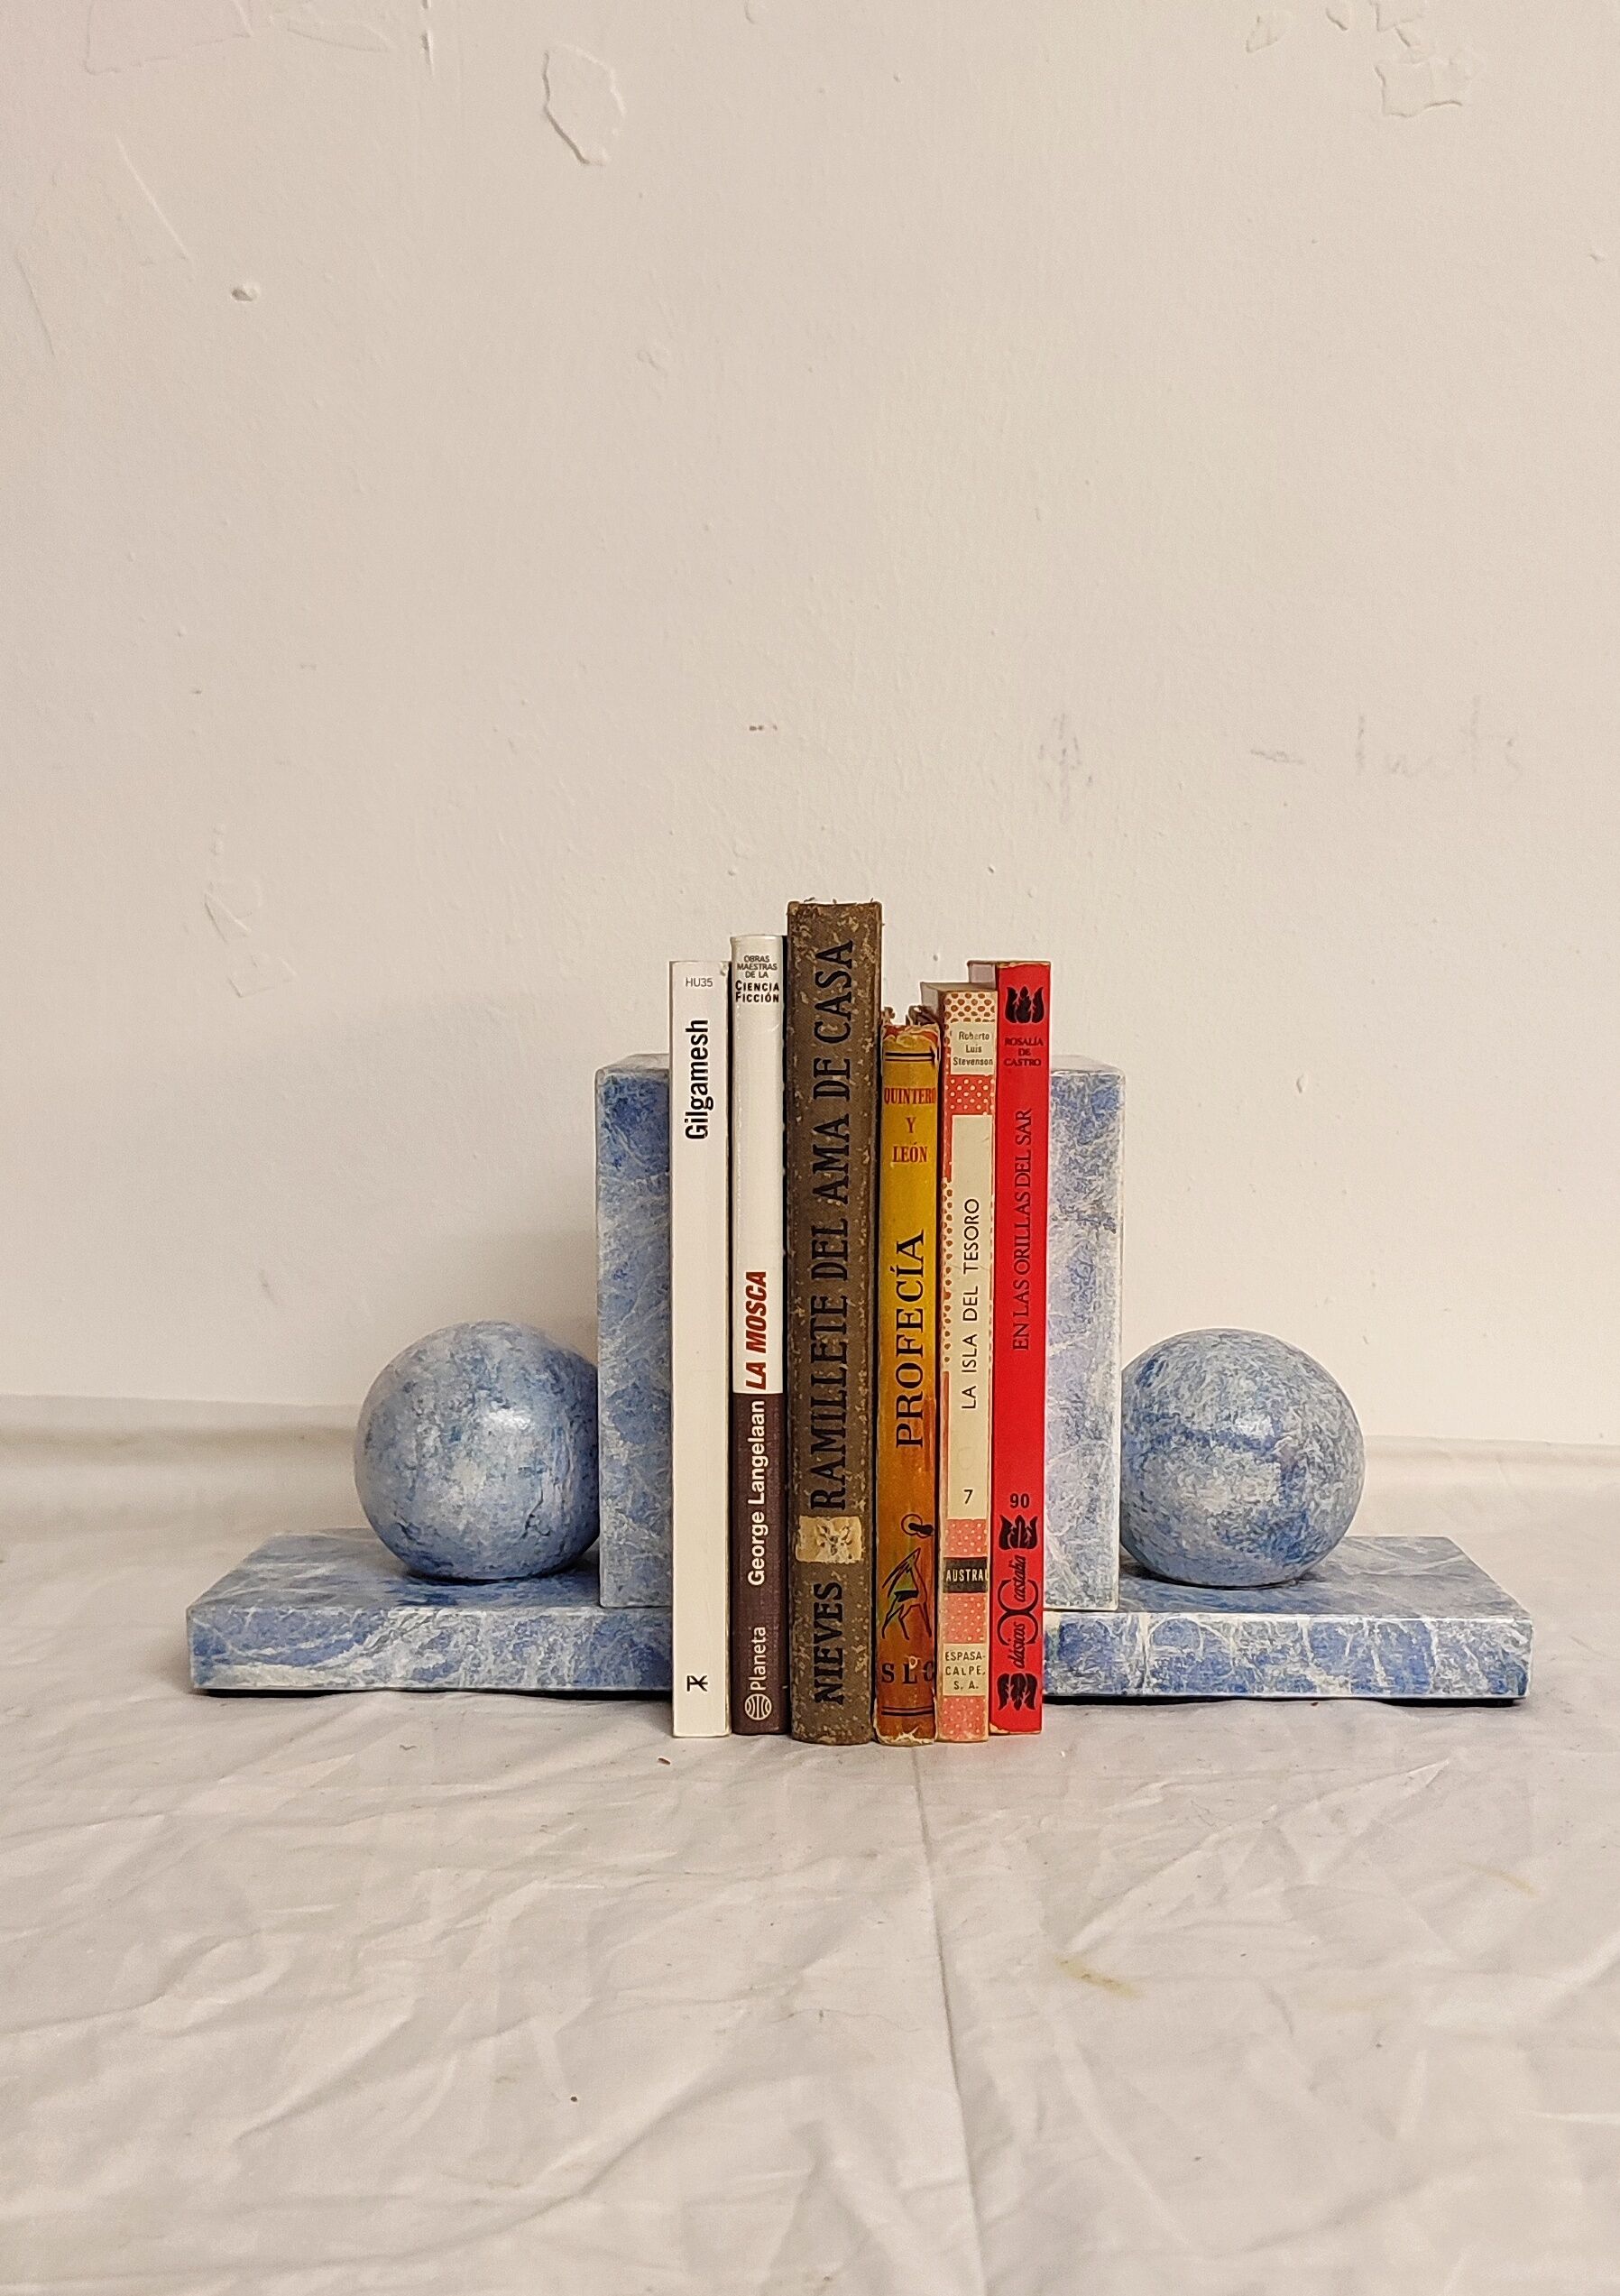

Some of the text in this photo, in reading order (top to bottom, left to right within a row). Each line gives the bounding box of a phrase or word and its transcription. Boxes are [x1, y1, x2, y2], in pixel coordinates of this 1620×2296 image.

[736, 963, 778, 971] MAESTRAS
[686, 977, 713, 988] HU35
[959, 1031, 989, 1040] Roberto
[1004, 1036, 1044, 1047] ROSALÍA
[966, 1044, 982, 1053] Luis
[1017, 1047, 1031, 1056] DE
[953, 1056, 993, 1066] Stevenson
[1003, 1057, 1041, 1066] CASTRO
[685, 1019, 714, 1139] Gilgamesh
[906, 1117, 916, 1133] Y
[893, 1142, 927, 1163] LEÓN
[811, 940, 853, 1510] RAMILLETE DEL AMA DE CASA
[1013, 1109, 1032, 1351] EN LAS ORILLAS DEL SAR
[962, 1198, 980, 1409] LA ISLA DEL TESORO
[745, 1271, 767, 1390] LA MOSCA
[890, 1230, 925, 1448] PROFECÍA
[748, 1400, 769, 1586] George Langelaan
[963, 1489, 973, 1504] 7
[1009, 1493, 1030, 1508] 90
[813, 1582, 844, 1705] NIEVES
[750, 1627, 767, 1692] Planeta
[944, 1651, 985, 1661] ESPASA-
